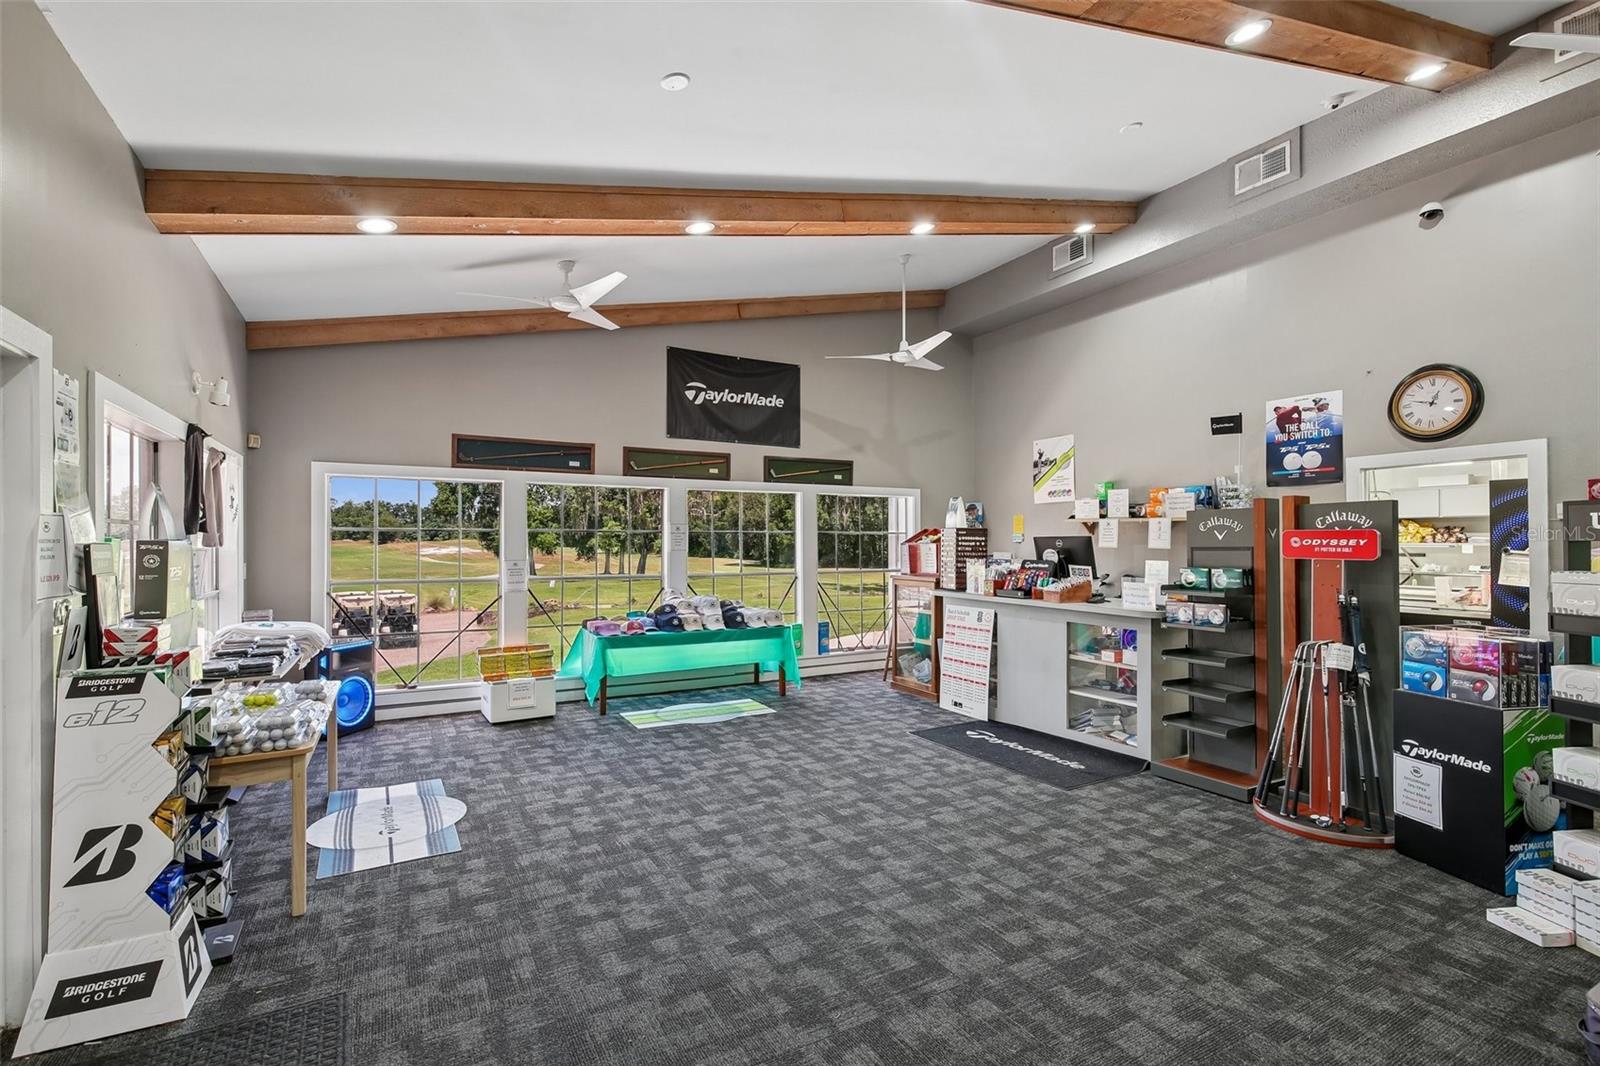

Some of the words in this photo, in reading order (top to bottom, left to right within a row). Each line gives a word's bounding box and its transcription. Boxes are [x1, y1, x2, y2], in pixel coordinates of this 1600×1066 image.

[684, 381, 785, 408] TaylorMade
[1285, 423, 1299, 433] THE
[1300, 420, 1320, 431] BALL
[1274, 433, 1288, 441] YOU
[1289, 430, 1318, 440] SWITCH
[1320, 428, 1333, 437] TO:
[1198, 516, 1244, 533] Callaway
[1315, 510, 1373, 529] Callaway
[1302, 538, 1368, 546] ODYSSEY
[77, 677, 137, 687] BRIDGESTONE
[1401, 739, 1492, 774] TaylorMade
[1509, 843, 1528, 852] DON'T
[1528, 841, 1545, 850] MAKE
[1518, 852, 1533, 860] PLAY
[62, 972, 147, 998] BRIDGESTONE
[81, 986, 128, 1004] GOLF
